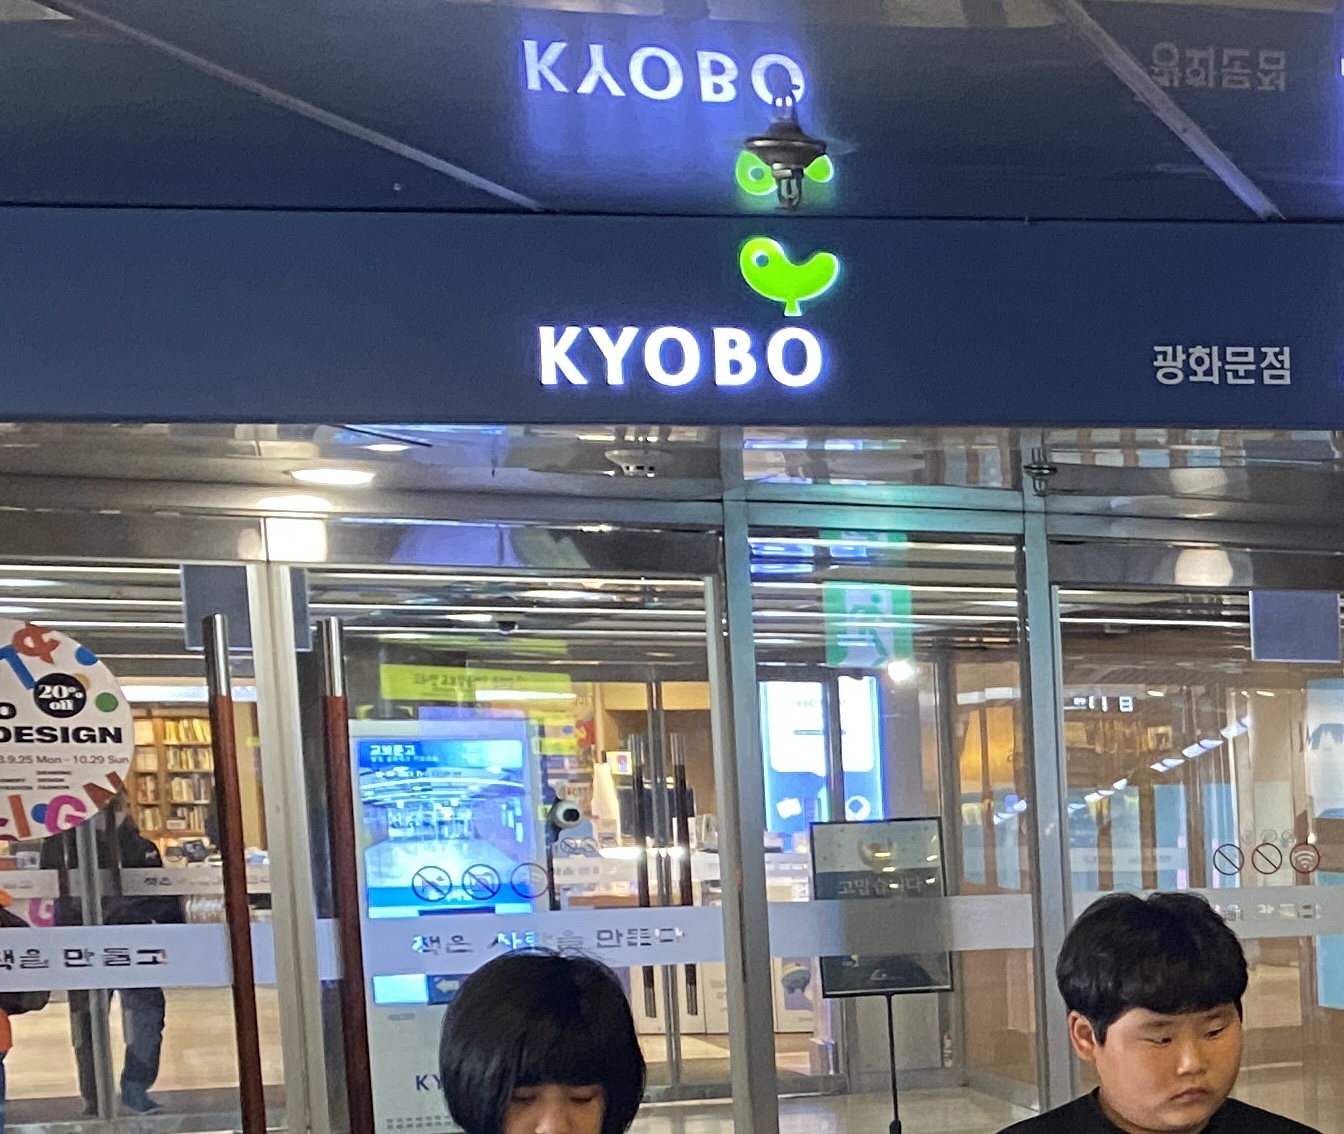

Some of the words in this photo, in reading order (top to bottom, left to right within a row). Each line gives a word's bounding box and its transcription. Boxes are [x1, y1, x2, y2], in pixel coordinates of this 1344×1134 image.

[538, 326, 823, 388] KYOBO
[1152, 345, 1292, 386] 광화문점
[64, 947, 168, 968] 만들고
